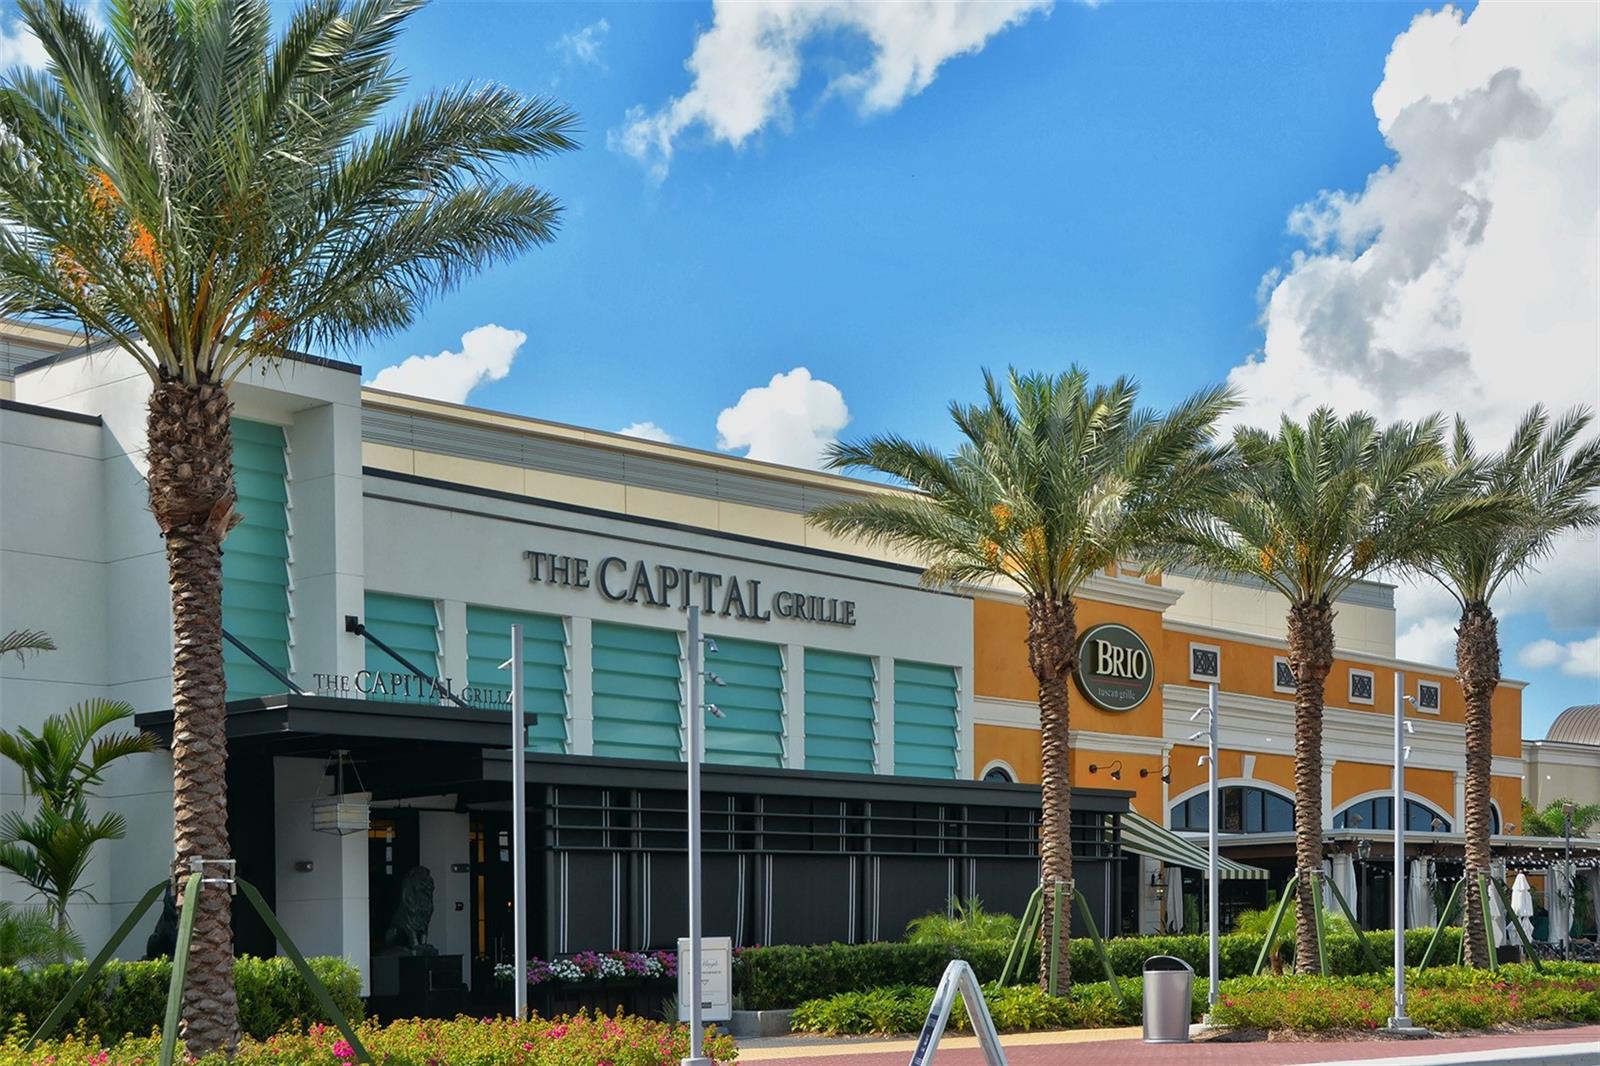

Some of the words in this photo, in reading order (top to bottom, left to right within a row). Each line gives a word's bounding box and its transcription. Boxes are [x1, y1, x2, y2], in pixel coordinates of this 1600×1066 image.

[523, 550, 590, 588] THE
[596, 556, 771, 622] CAPITAL
[773, 590, 857, 626] GRILLE
[1095, 639, 1147, 680] BRIO
[312, 673, 350, 692] THE
[354, 669, 461, 700] CAPITAL
